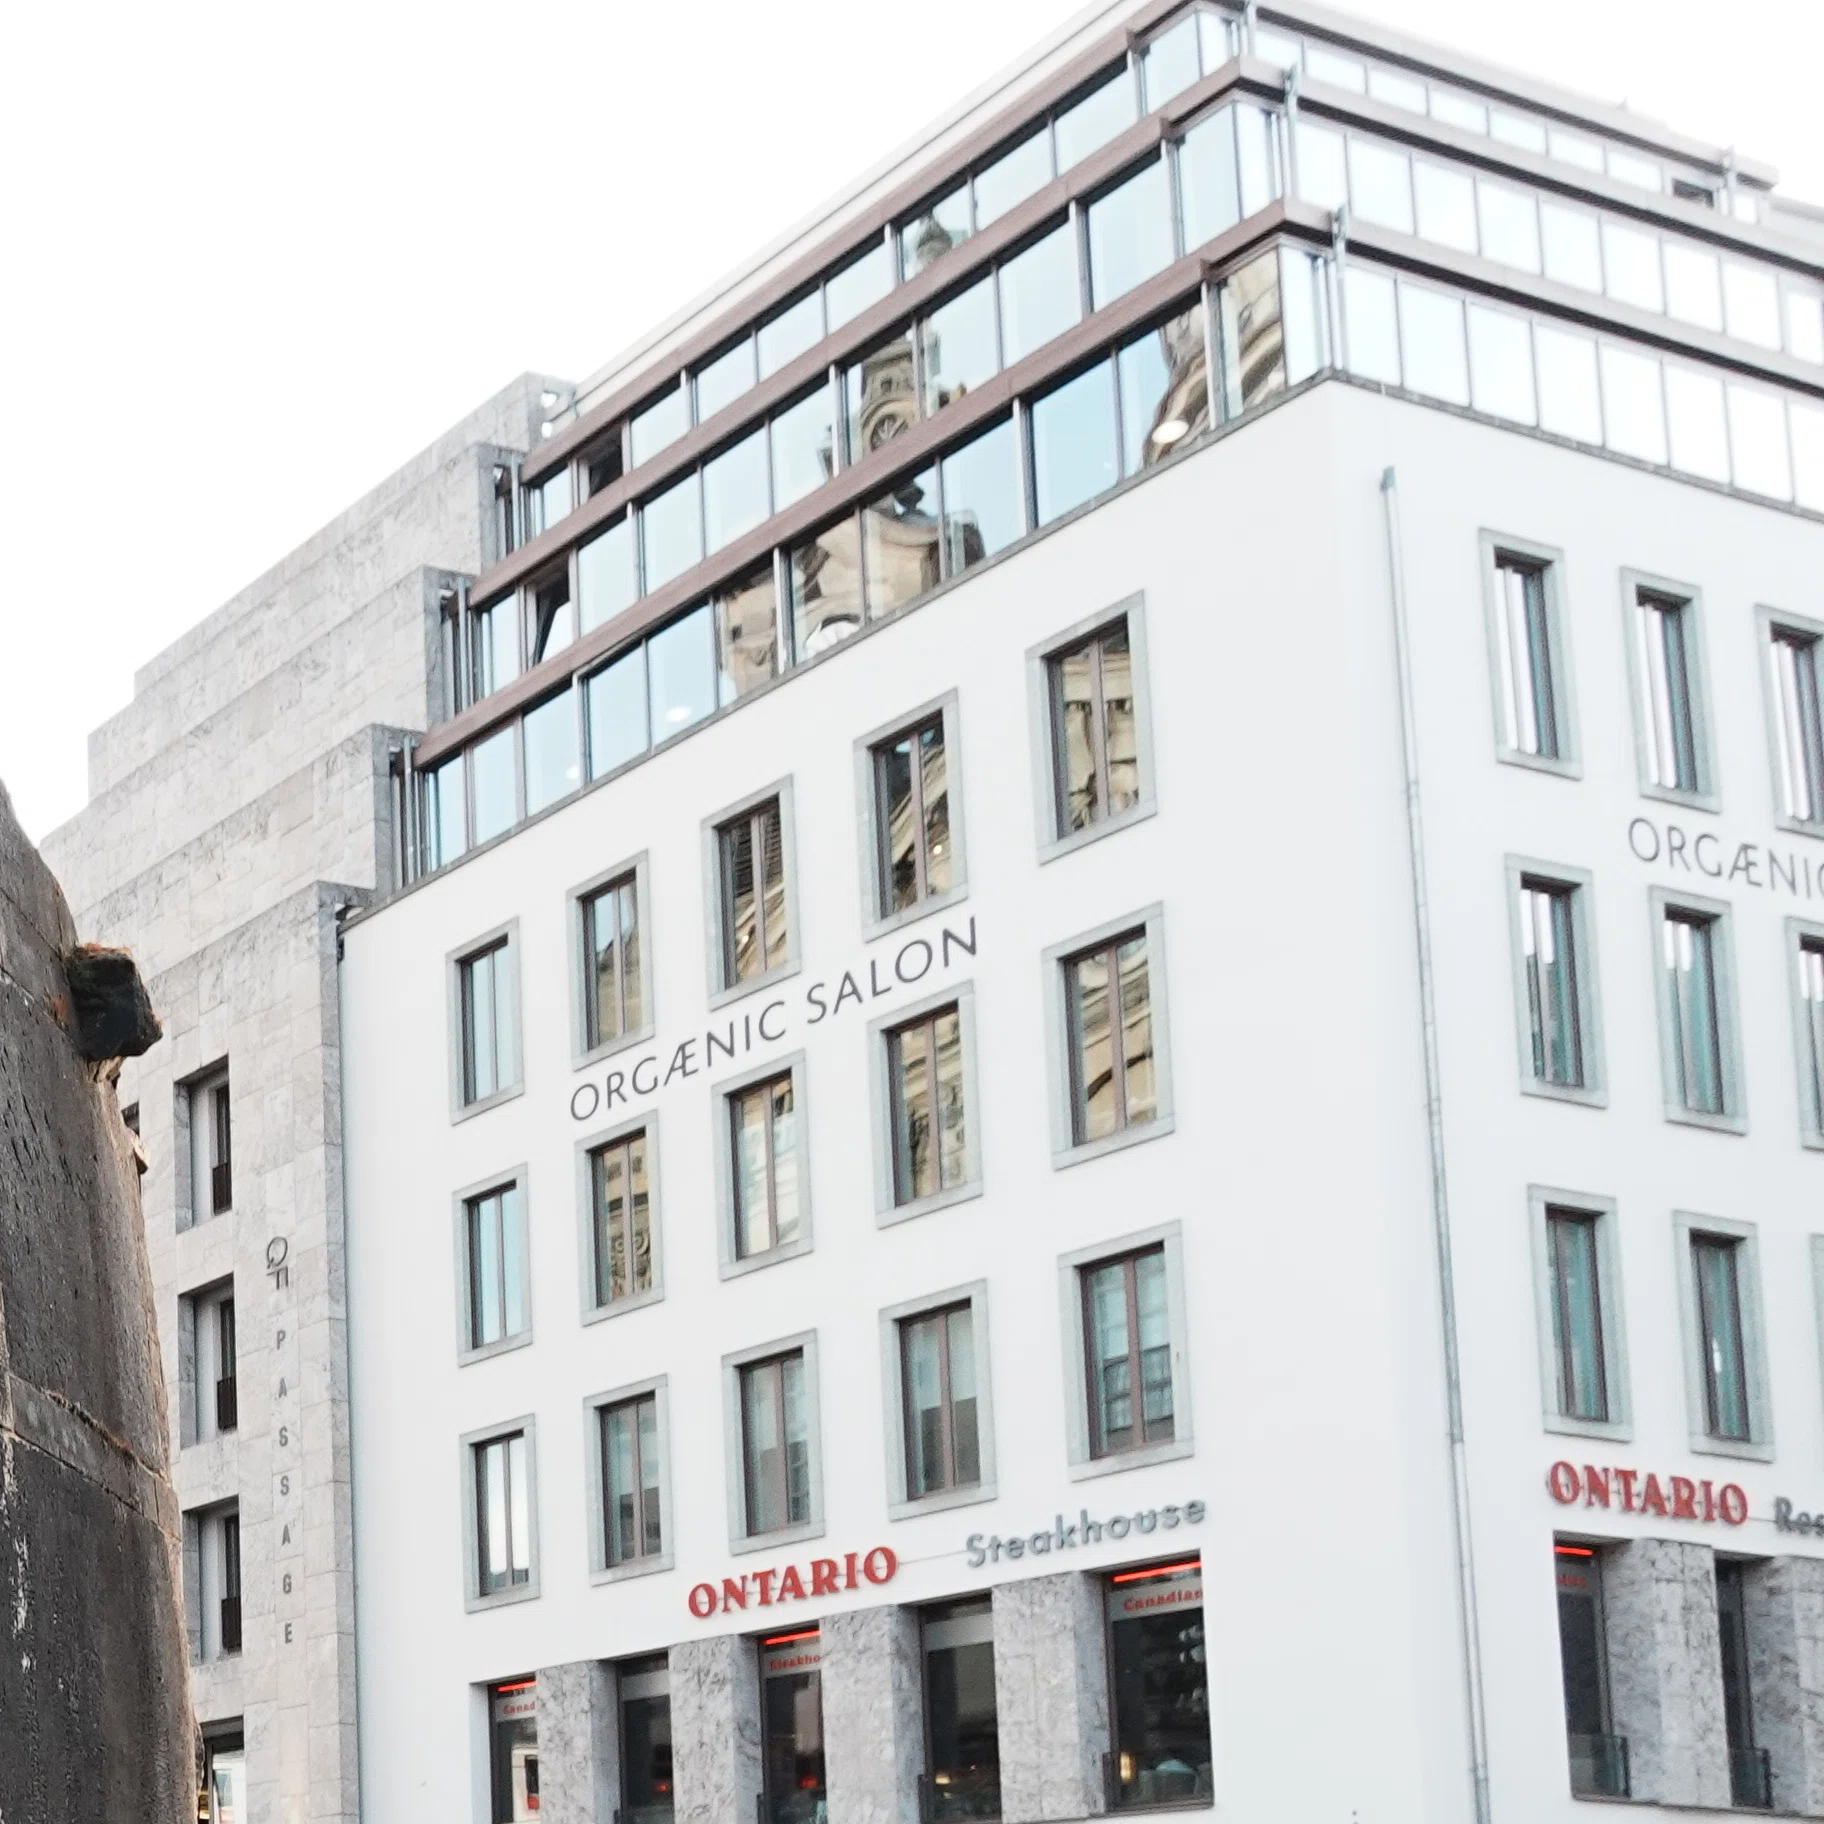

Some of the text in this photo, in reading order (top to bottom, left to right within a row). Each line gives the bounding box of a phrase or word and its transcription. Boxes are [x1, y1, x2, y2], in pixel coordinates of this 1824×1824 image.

[1628, 817, 1824, 900] ORGÆNI
[569, 915, 978, 1122] ORGÆNIC SALON
[275, 1329, 293, 1645] PASSAGE
[1548, 1460, 1749, 1526] ONTARIO
[687, 1499, 1206, 1619] ONTARIO Steakhouse
